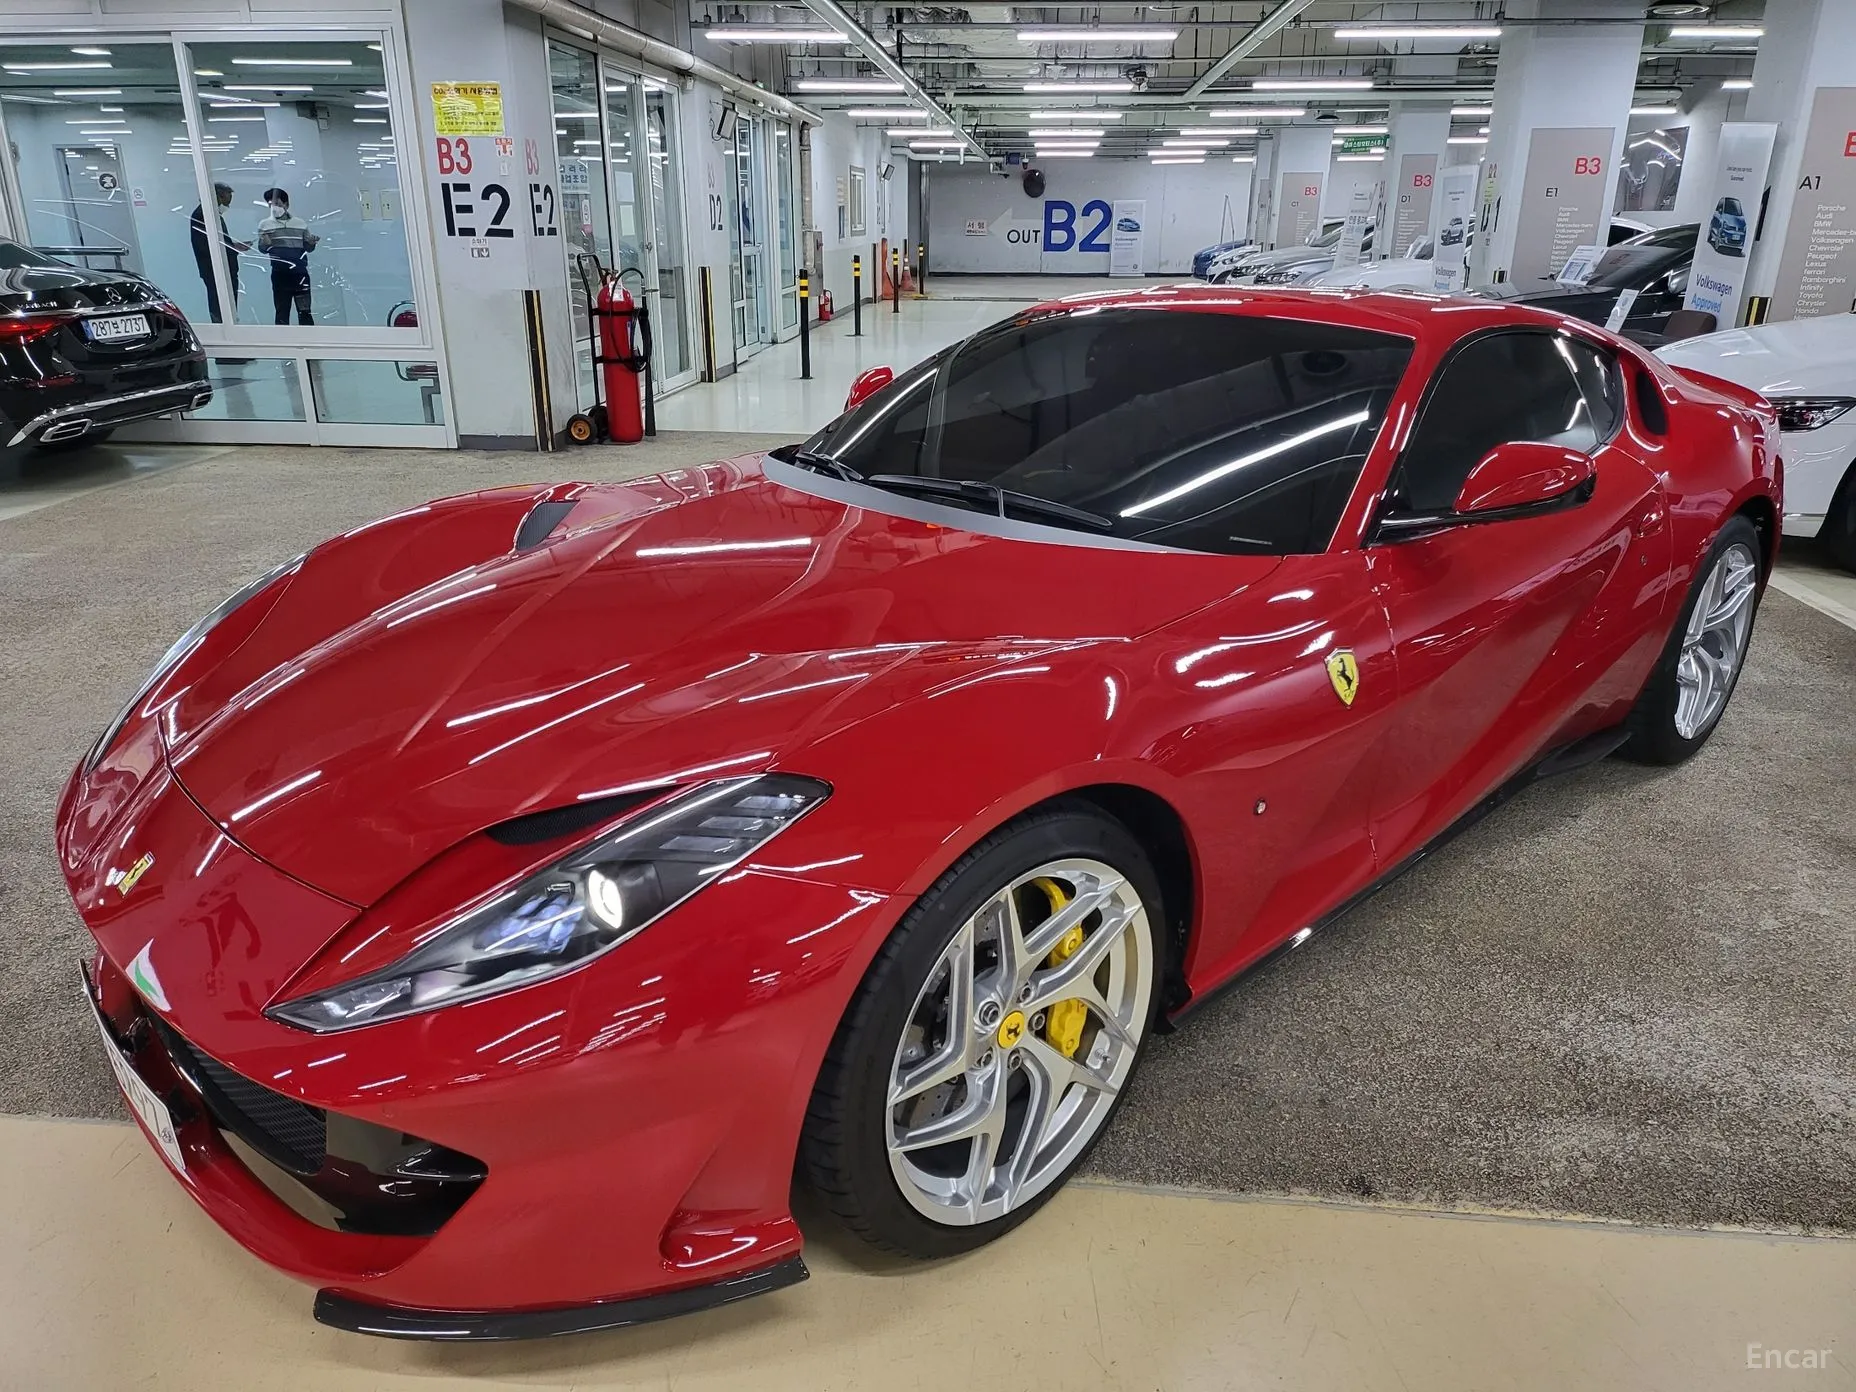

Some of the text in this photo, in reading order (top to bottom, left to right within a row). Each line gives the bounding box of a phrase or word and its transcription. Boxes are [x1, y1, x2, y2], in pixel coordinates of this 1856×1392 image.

[436, 137, 473, 175] B3
[525, 139, 539, 175] B3
[1574, 157, 1601, 175] B3
[1414, 174, 1433, 187] B3
[1799, 175, 1822, 190] A1
[1304, 186, 1318, 196] B3
[1401, 195, 1411, 203] D1
[1546, 187, 1559, 197] E1
[441, 183, 514, 238] E2
[529, 184, 558, 236] E2
[709, 194, 723, 231] D2
[1006, 200, 1113, 252] OUT B2
[1811, 236, 1854, 245] Volkswagen
[1807, 252, 1837, 260] Peugeot
[1696, 273, 1733, 297] Volkswagen
[1691, 293, 1722, 314] Approved
